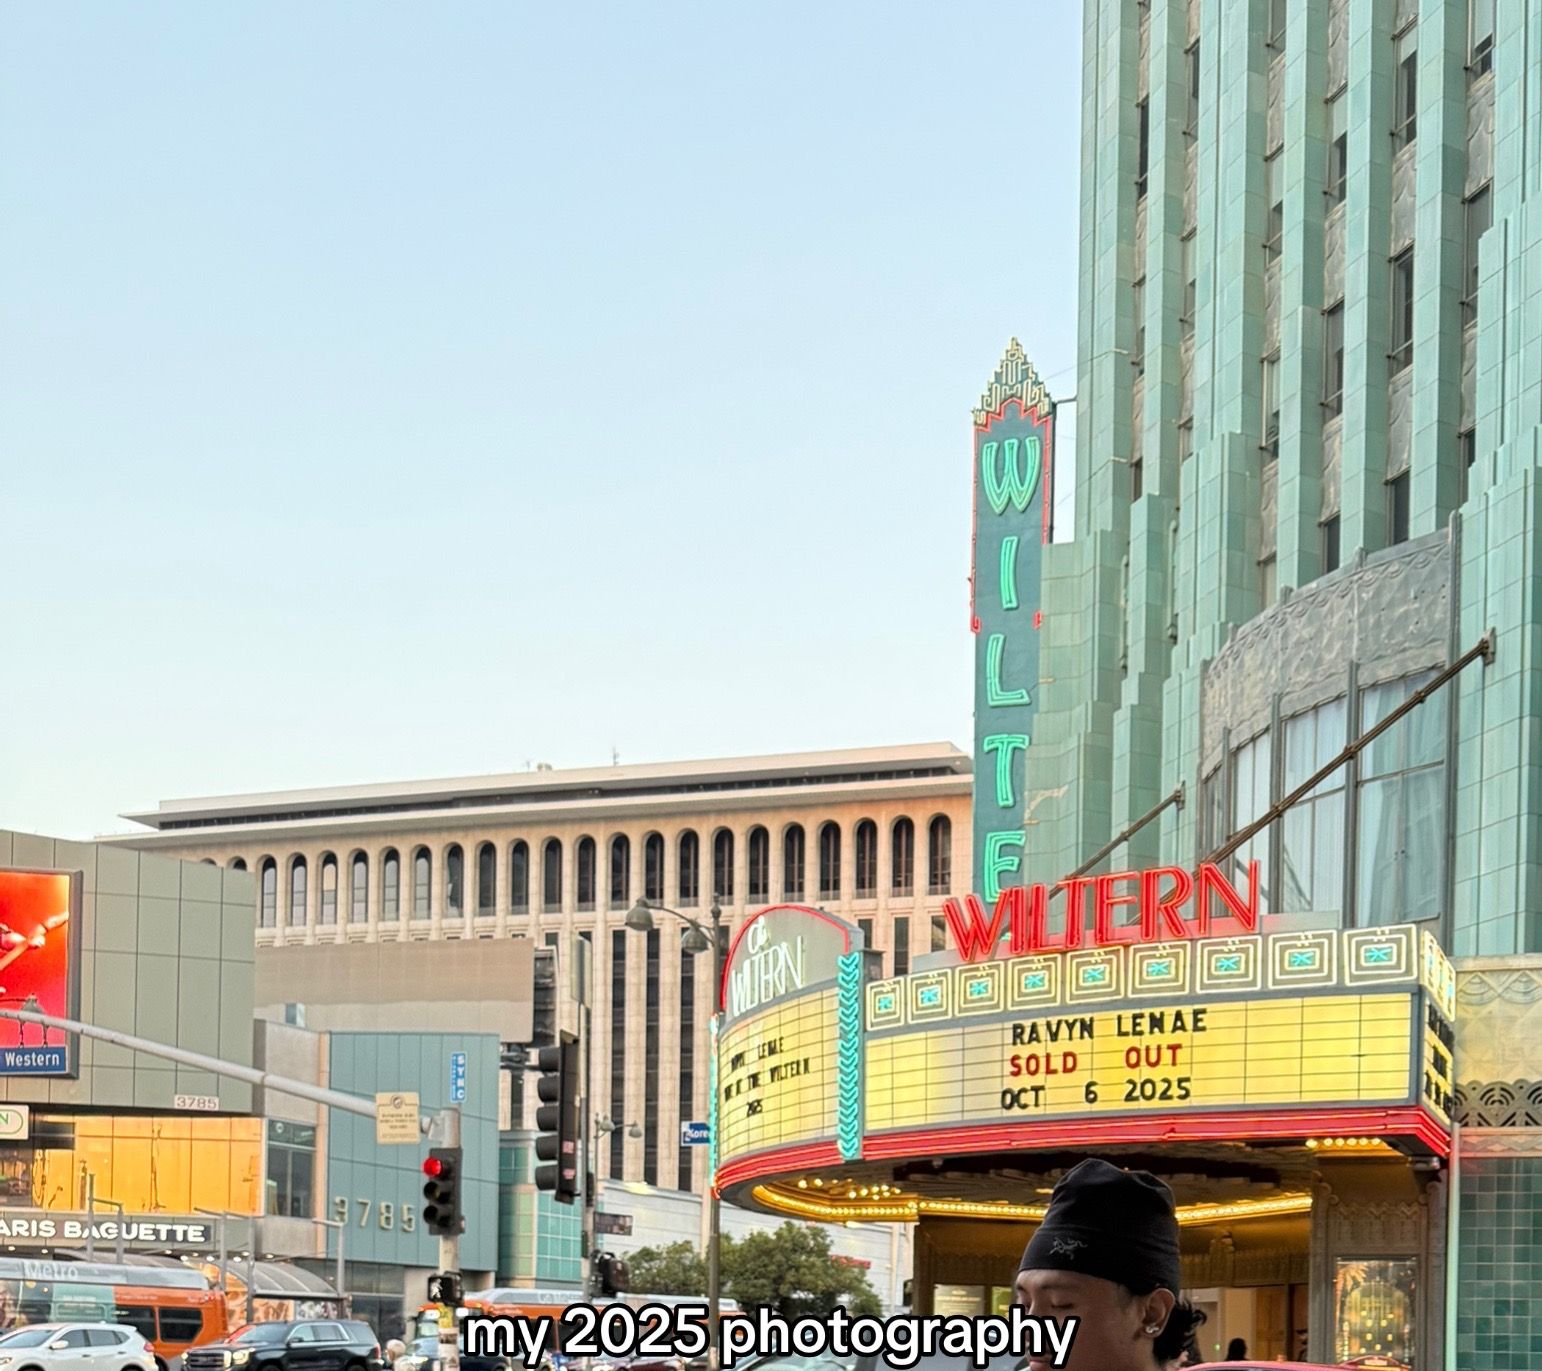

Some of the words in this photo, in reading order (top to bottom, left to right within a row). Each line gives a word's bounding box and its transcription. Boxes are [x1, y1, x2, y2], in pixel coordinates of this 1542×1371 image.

[982, 436, 1041, 904] WILTE
[943, 860, 1260, 961] WILTERN
[1012, 1017, 1095, 1046] RAVYN
[1116, 1008, 1207, 1038] LENAE
[5, 1051, 60, 1067] Western
[1009, 1051, 1078, 1077] SOLD
[1125, 1044, 1183, 1069] OUT
[177, 1097, 217, 1108] 3785
[1001, 1085, 1045, 1110] OCT
[1084, 1081, 1098, 1104] 6
[1123, 1077, 1191, 1102] 2025
[335, 1196, 415, 1232] 3785
[0, 1219, 56, 1237] ARIS
[64, 1221, 206, 1243] BAGUETTE
